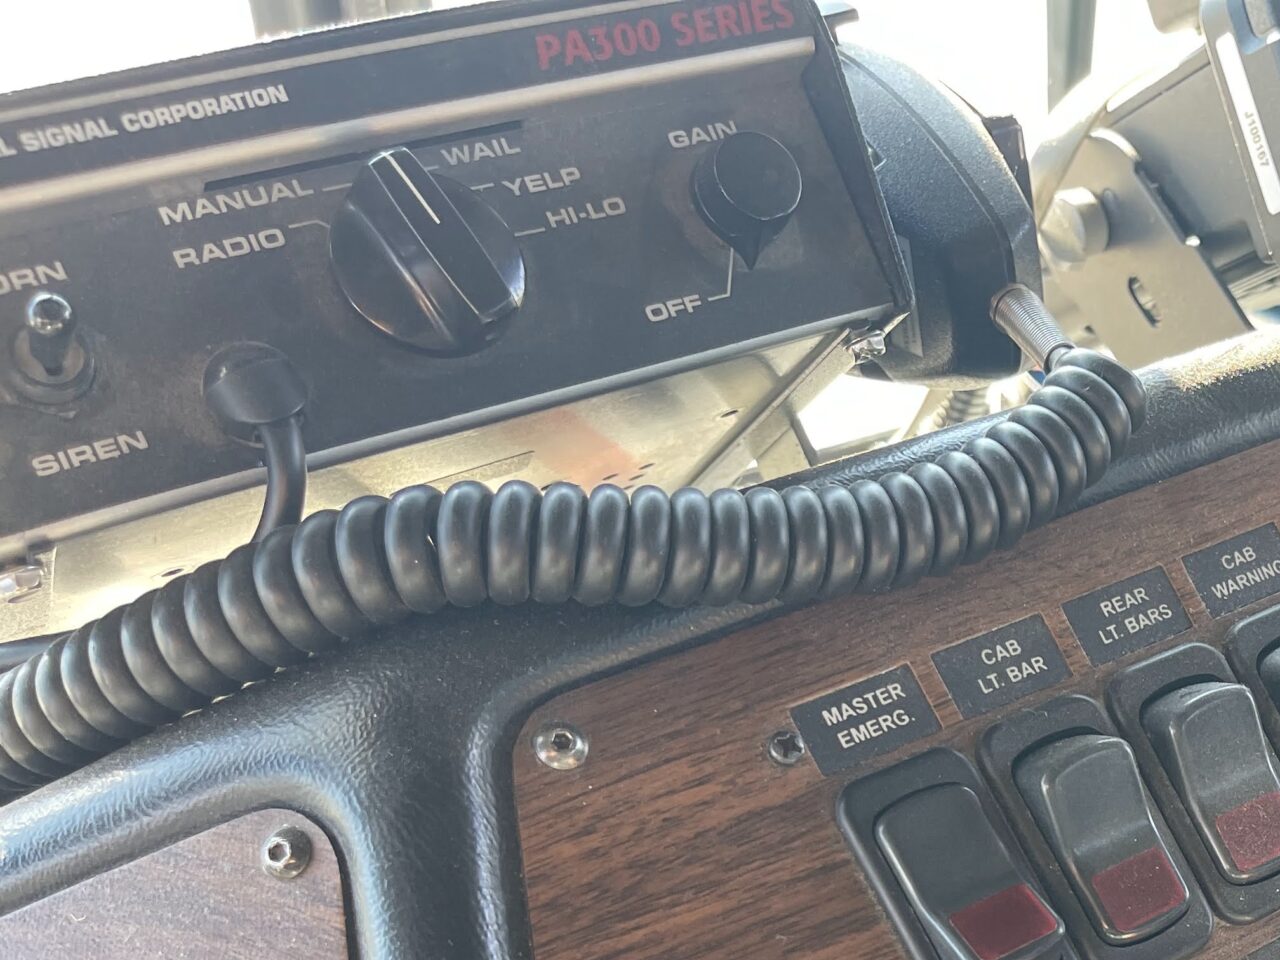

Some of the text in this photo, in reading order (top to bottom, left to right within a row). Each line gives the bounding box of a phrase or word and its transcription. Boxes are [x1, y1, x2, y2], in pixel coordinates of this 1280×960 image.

[535, 0, 794, 69] PA300 SERIES
[22, 118, 118, 152] SIGNAL
[122, 84, 289, 132] CORPORATION
[667, 120, 738, 149] GAIN
[441, 138, 521, 166] WAIL
[158, 178, 313, 225] MANUAL
[502, 167, 581, 197] YELP
[545, 197, 626, 229] HI-LO
[172, 228, 286, 269] RADIO
[645, 295, 702, 322] OFF
[31, 431, 150, 477] SIREN
[1221, 546, 1257, 570] CAB
[1099, 587, 1150, 618] REAR
[1098, 603, 1173, 645] LT. BARS
[981, 639, 1022, 665] CAB
[977, 656, 1048, 695] LT. BAR
[821, 683, 906, 727] MASTER
[837, 708, 916, 750] EMERG.
